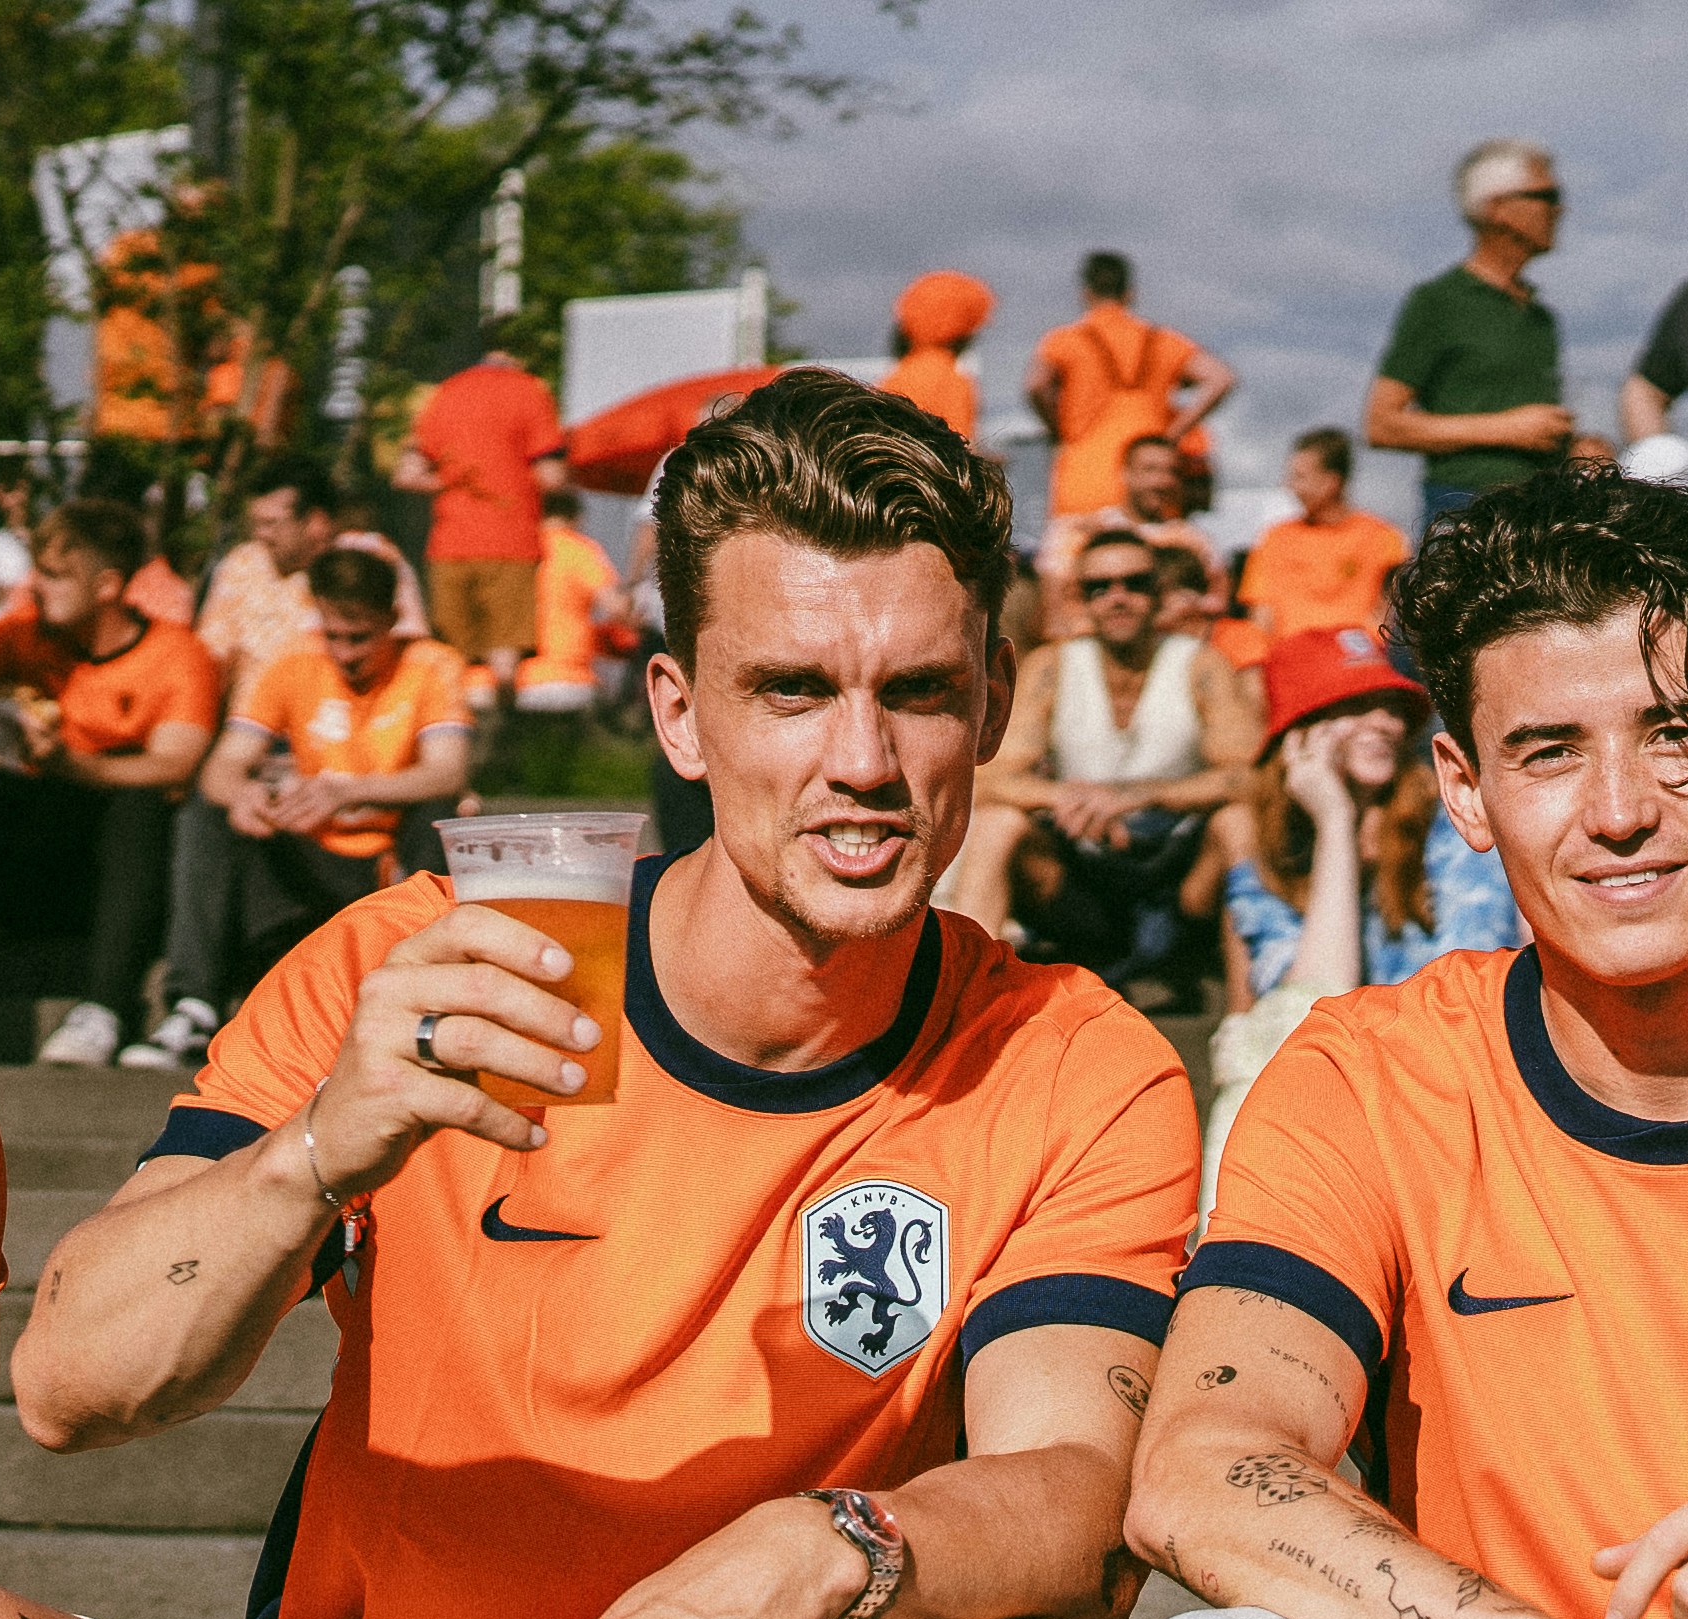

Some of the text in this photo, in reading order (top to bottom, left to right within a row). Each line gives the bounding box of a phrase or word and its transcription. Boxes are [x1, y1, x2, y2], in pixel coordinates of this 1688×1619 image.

[850, 1192, 898, 1207] KNVB
[1268, 1538, 1315, 1568] SAMEN
[1319, 1564, 1362, 1599] ALLES
